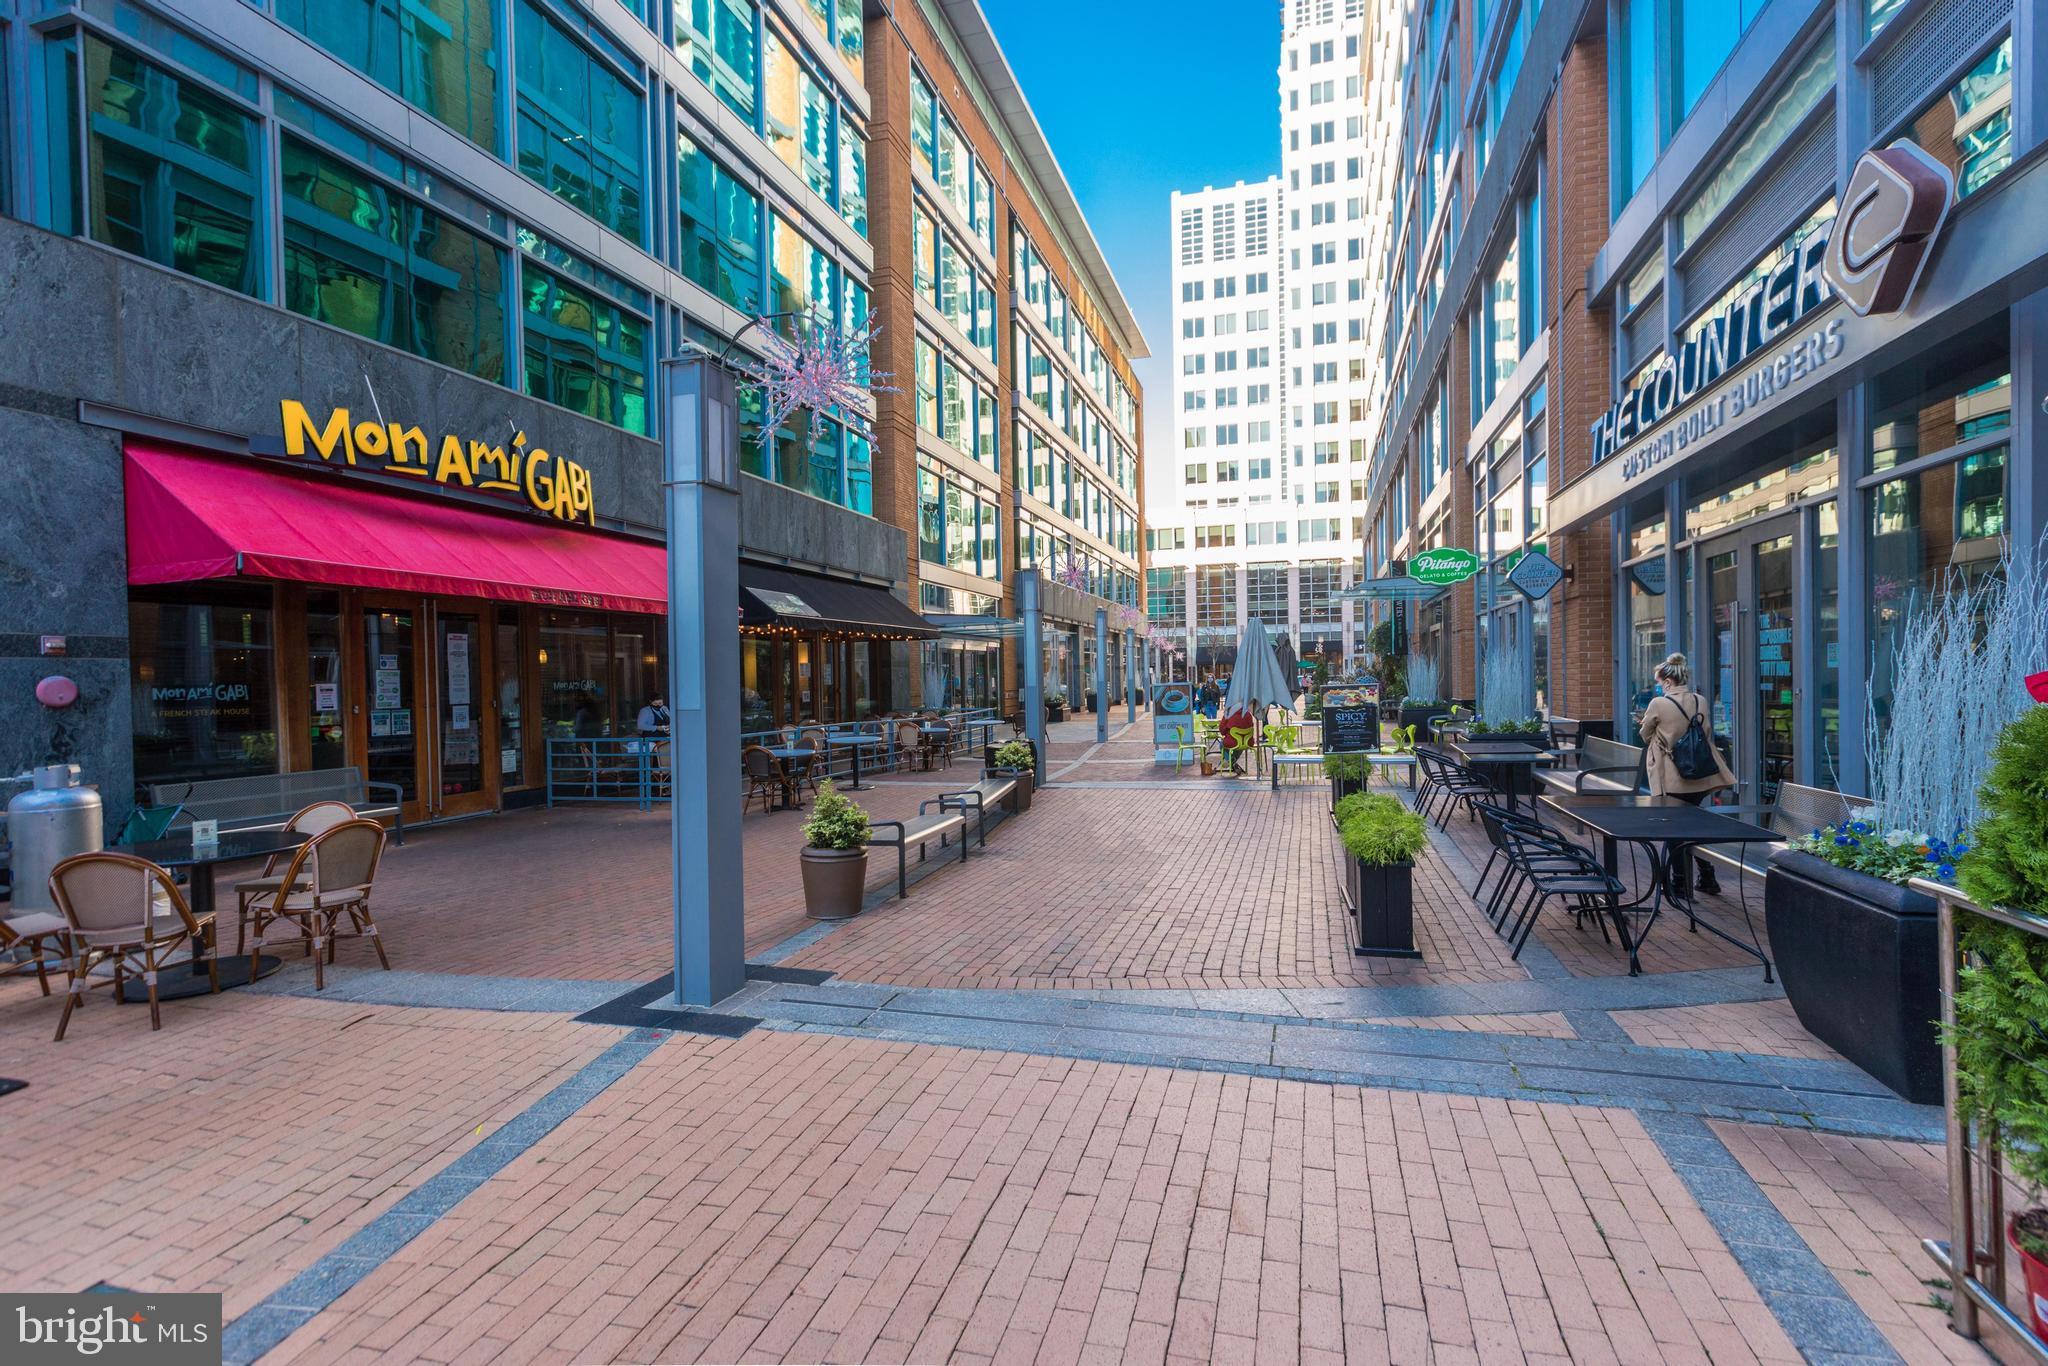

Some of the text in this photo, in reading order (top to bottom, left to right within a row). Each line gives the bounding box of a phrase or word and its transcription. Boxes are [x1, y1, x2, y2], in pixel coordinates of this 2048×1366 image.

[1591, 218, 1836, 465] THE COUNTER
[1622, 318, 1845, 482] CUSTOM BUILT BURGERS
[281, 400, 428, 475] Mon
[525, 448, 595, 527] GABI
[1417, 556, 1471, 572] Pitango
[160, 709, 191, 718] FRENCH
[194, 708, 221, 717] STEAK
[223, 707, 250, 716] HOUSE
[215, 684, 249, 701] GABI
